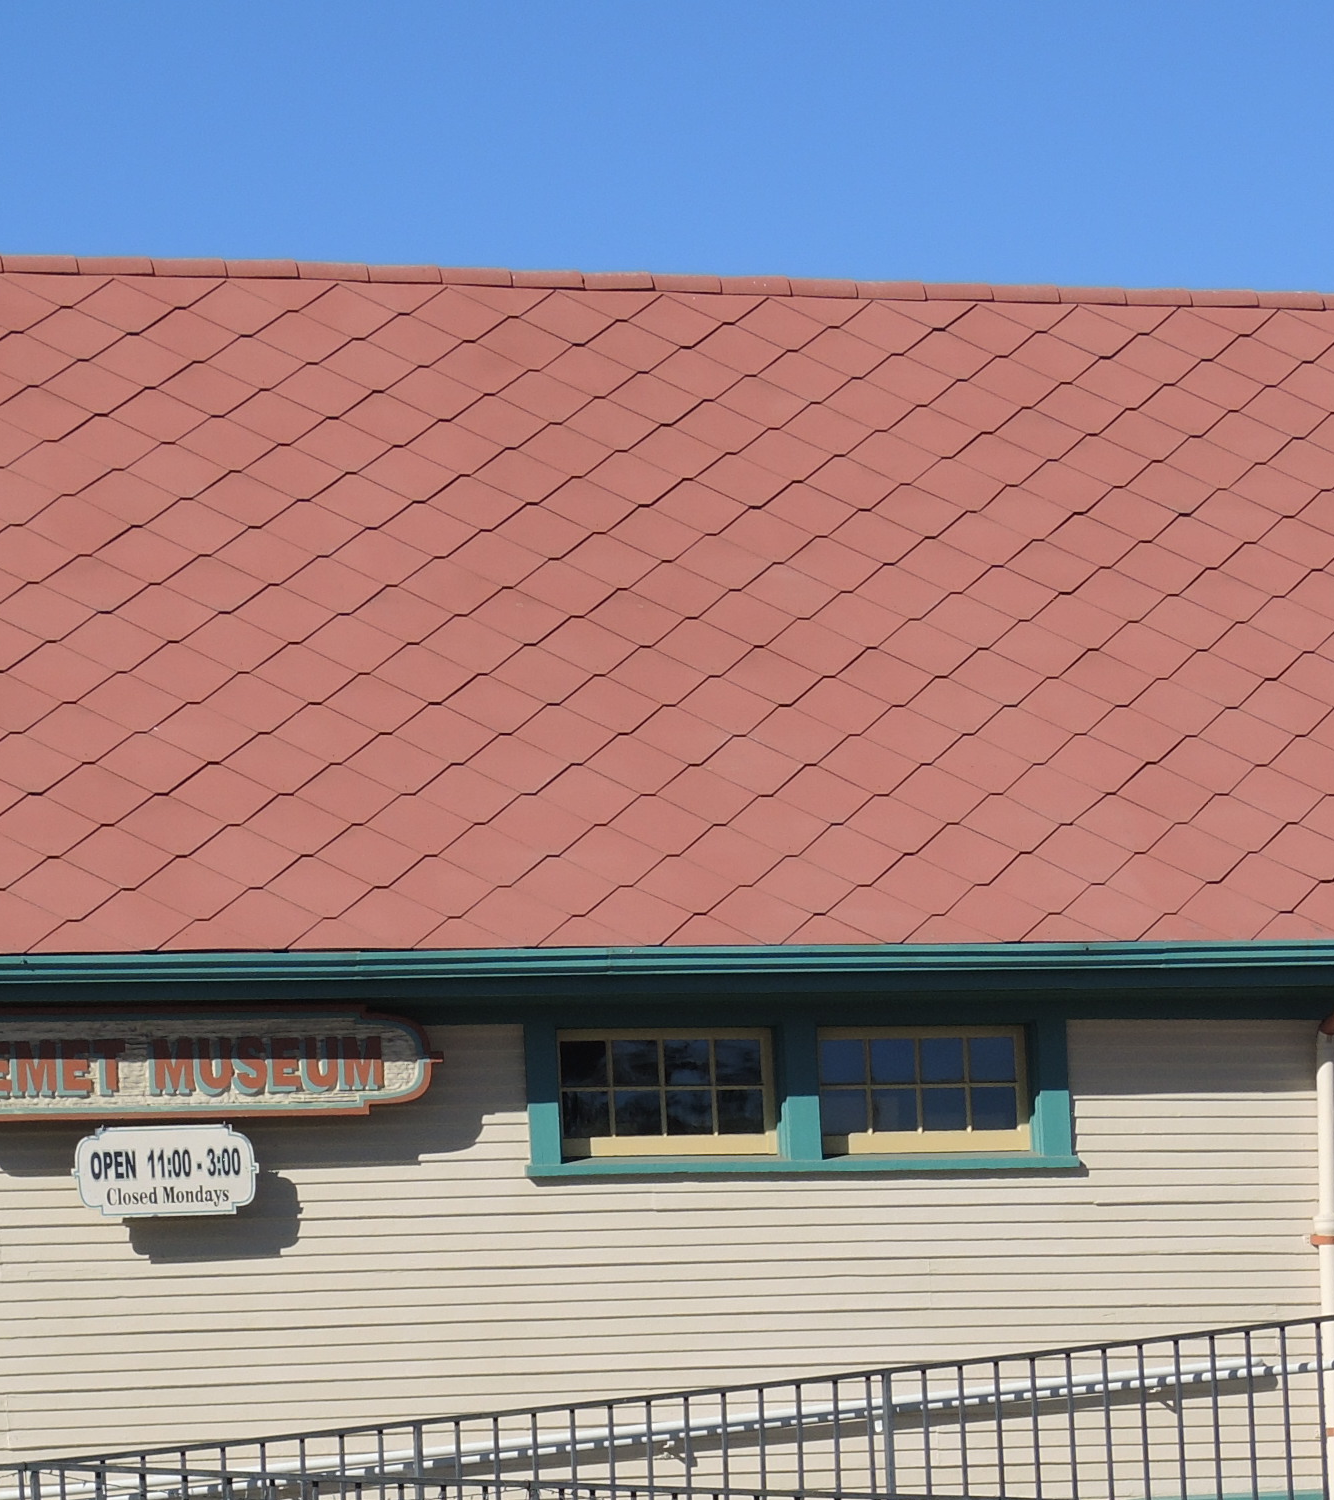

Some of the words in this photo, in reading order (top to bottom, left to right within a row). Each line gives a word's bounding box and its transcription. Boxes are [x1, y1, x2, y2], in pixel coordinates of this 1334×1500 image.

[148, 1035, 385, 1096] MUSEUM
[90, 1150, 137, 1180] OPEN
[147, 1149, 192, 1179] 11:00
[207, 1147, 241, 1177] 3:00
[106, 1185, 159, 1207] Closed
[162, 1184, 230, 1208] Mondays
